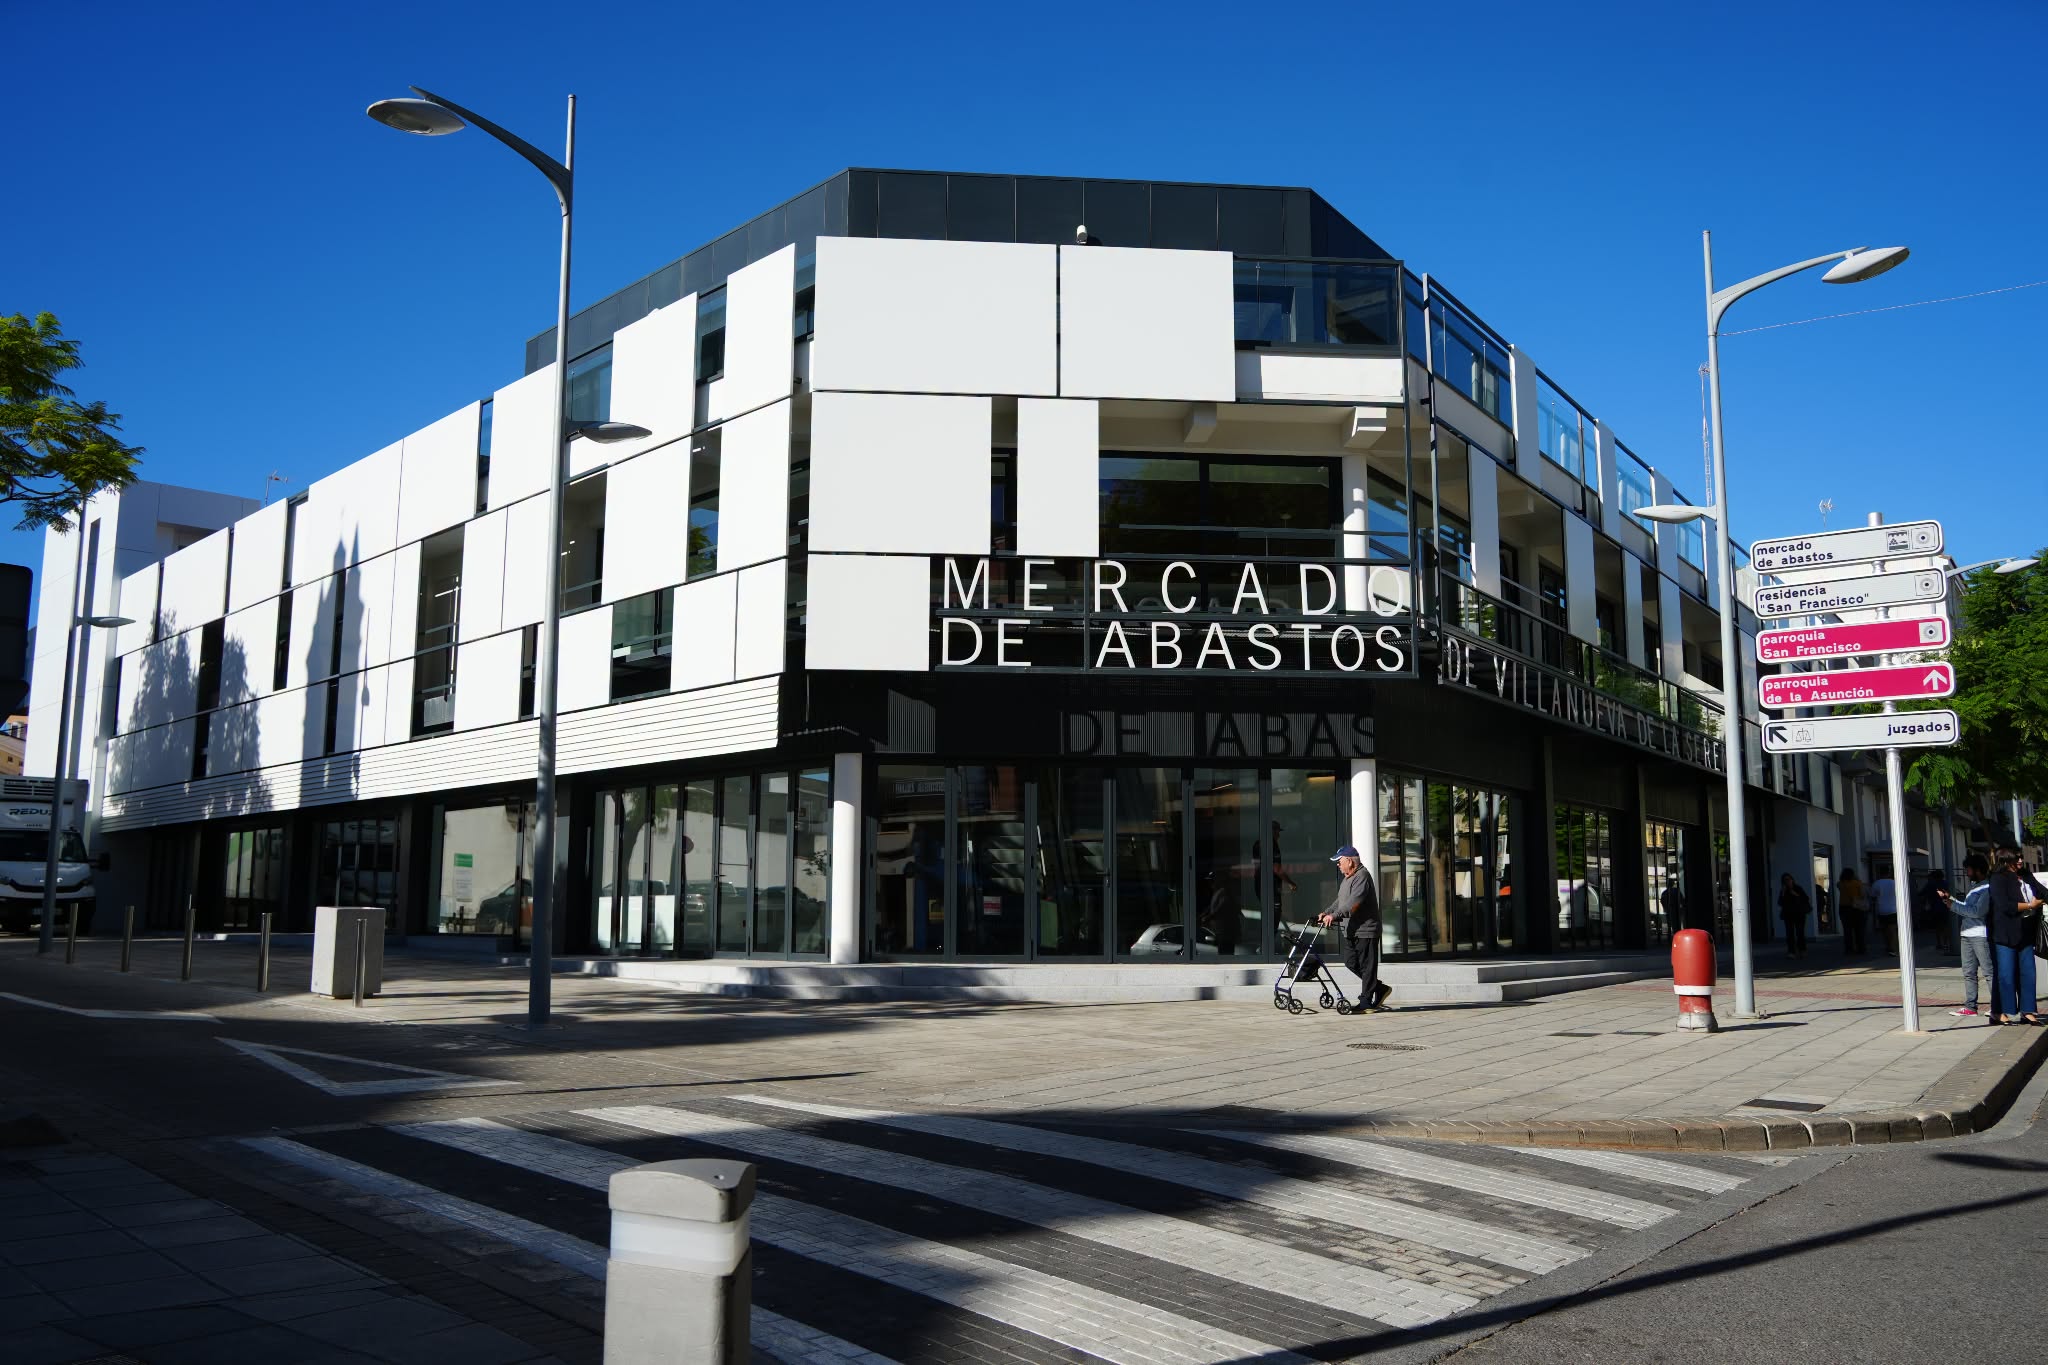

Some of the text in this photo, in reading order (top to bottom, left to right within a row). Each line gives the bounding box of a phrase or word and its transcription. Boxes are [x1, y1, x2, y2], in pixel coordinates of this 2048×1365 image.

[1756, 541, 1812, 555] mercado
[1758, 551, 1834, 568] de abastos
[944, 557, 1405, 617] MERCADO
[1759, 586, 1827, 601] residencia
[1760, 593, 1869, 613] "San Francisco"
[942, 618, 1405, 672] DE ABASTOS
[1762, 631, 1826, 646] parroquia
[1763, 642, 1862, 659] San Francisco
[1765, 677, 1829, 692] parroquia
[1447, 637, 1478, 689] DE
[1493, 655, 1628, 740] VILLANUEVA
[1636, 711, 1657, 749] DE
[1662, 722, 1681, 759] LA
[1766, 687, 1874, 704] de la Asunción
[1887, 721, 1951, 737] juzgados
[9, 808, 53, 816] REDU
